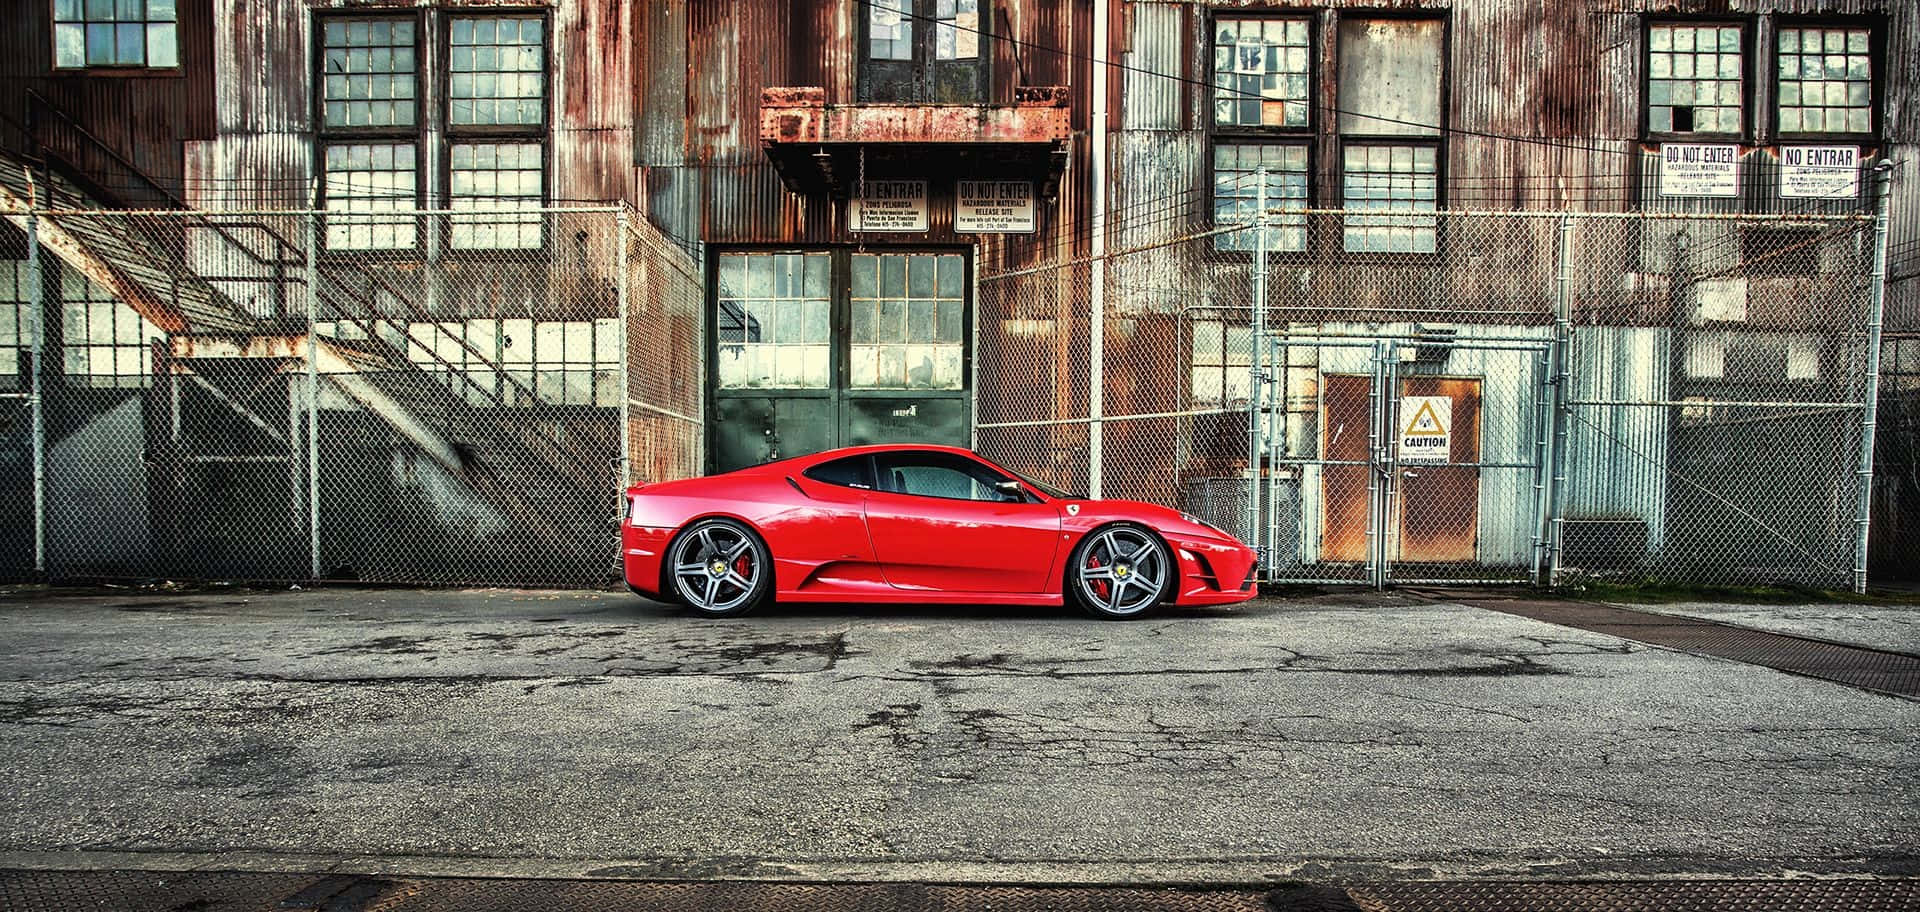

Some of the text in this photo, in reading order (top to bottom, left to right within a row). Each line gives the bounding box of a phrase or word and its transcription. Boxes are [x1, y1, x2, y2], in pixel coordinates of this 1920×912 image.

[1666, 146, 1733, 163] DO NOT ENTER
[1786, 149, 1852, 166] NO ENTRAR
[877, 183, 923, 199] ENTRAR
[961, 183, 1029, 199] DO NOT ENTER
[1404, 438, 1446, 447] CAUTION
